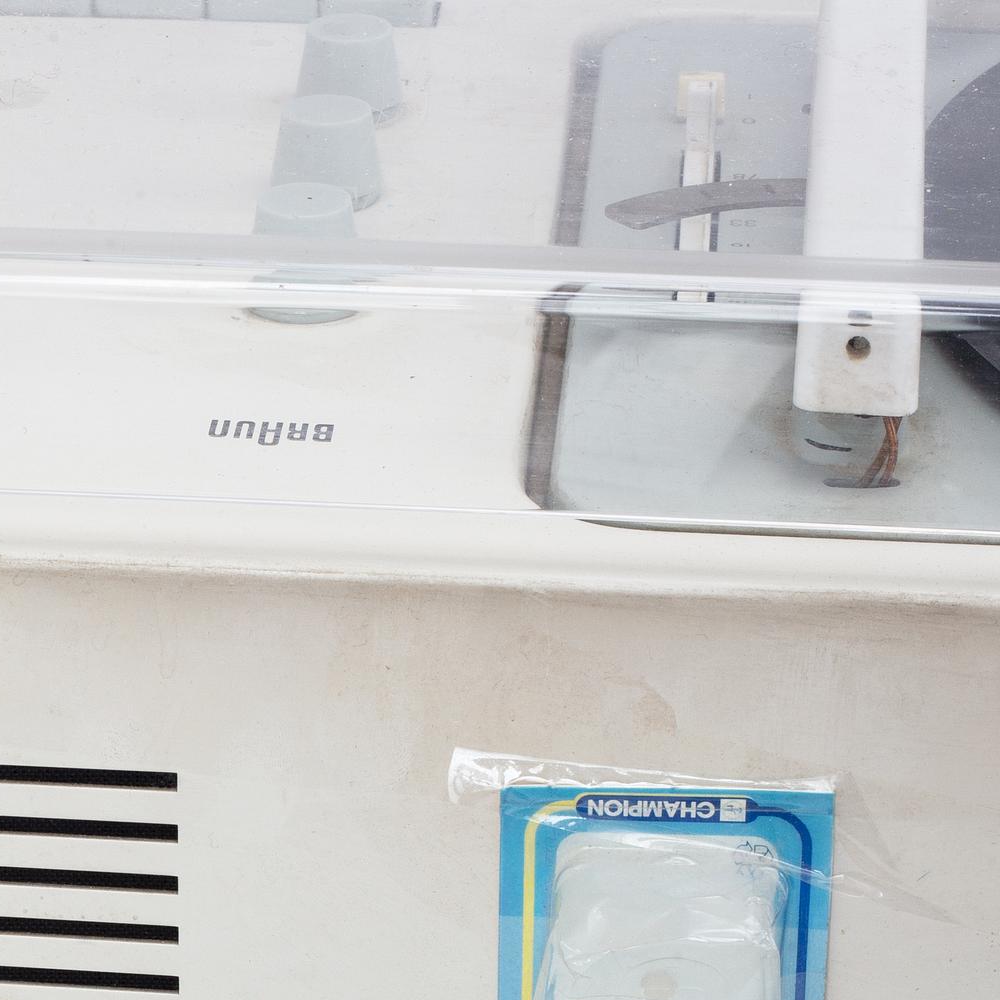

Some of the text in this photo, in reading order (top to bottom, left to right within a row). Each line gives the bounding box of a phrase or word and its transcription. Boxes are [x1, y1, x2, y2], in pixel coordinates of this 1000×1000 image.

[729, 218, 757, 228] 33
[207, 419, 335, 446] BRAUN
[587, 798, 716, 819] CHAMPION
